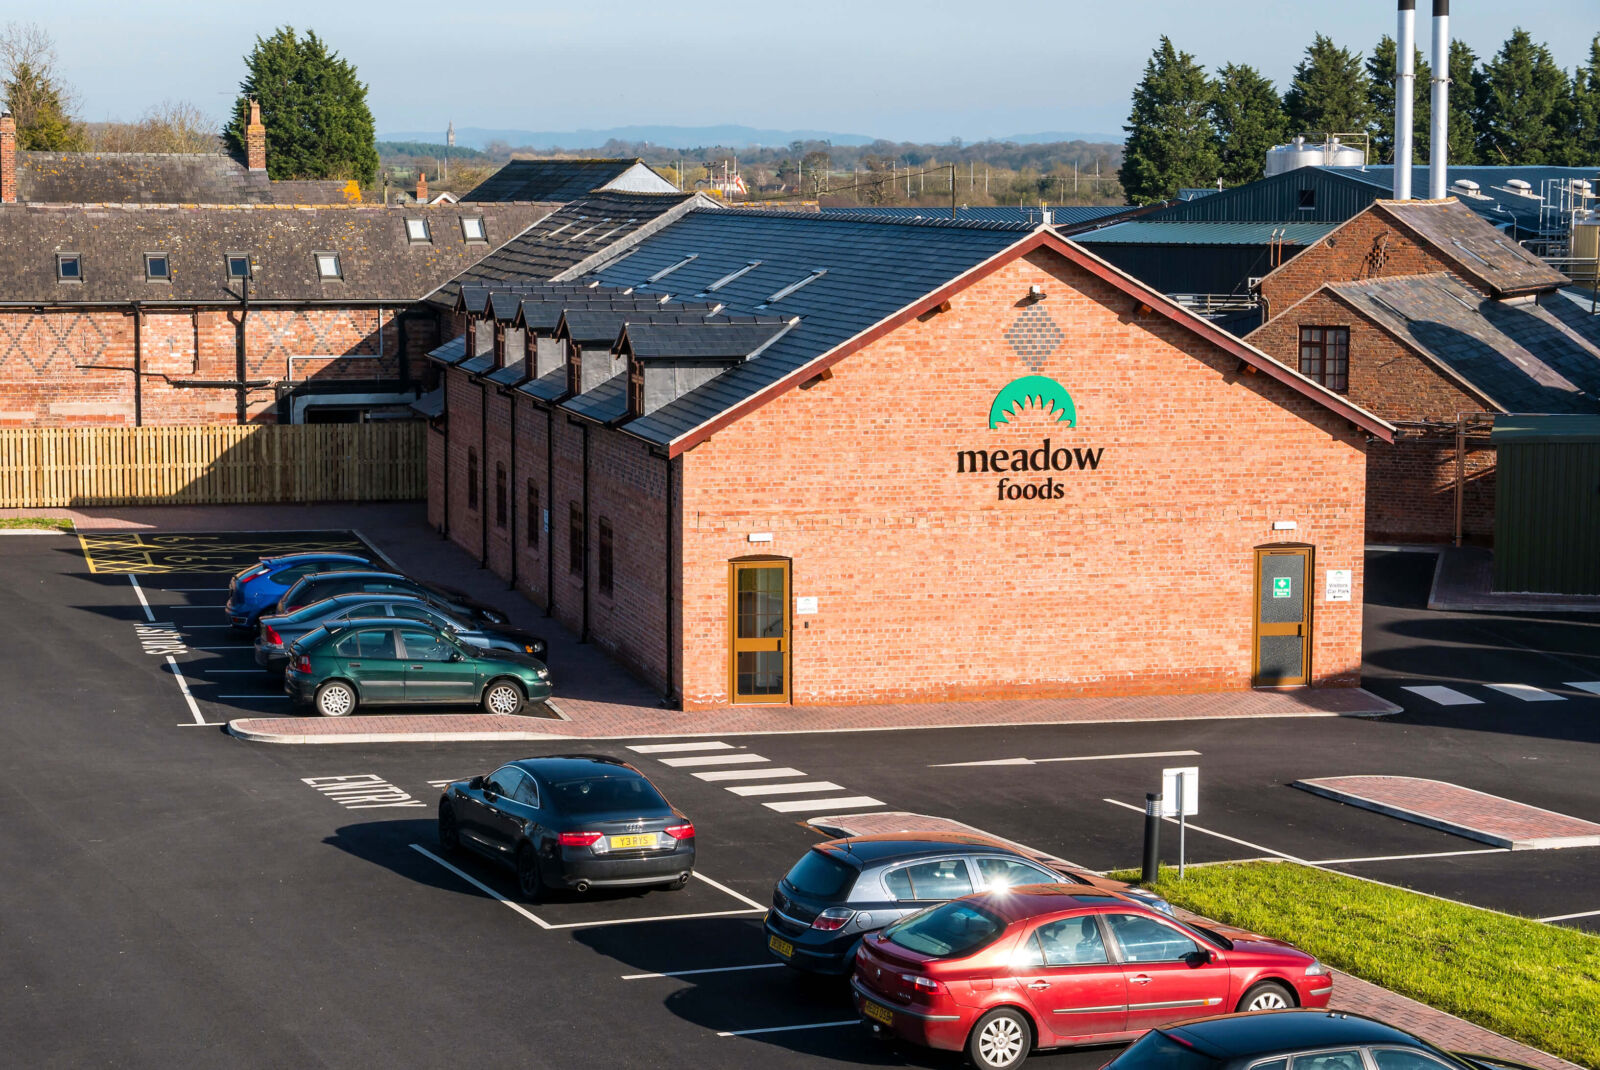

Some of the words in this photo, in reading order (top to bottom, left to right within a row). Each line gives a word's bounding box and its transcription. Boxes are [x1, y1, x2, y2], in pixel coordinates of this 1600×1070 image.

[957, 438, 1105, 473] meadow
[997, 477, 1065, 500] foods
[133, 621, 189, 655] VISITORS
[300, 774, 427, 809] ENTRY
